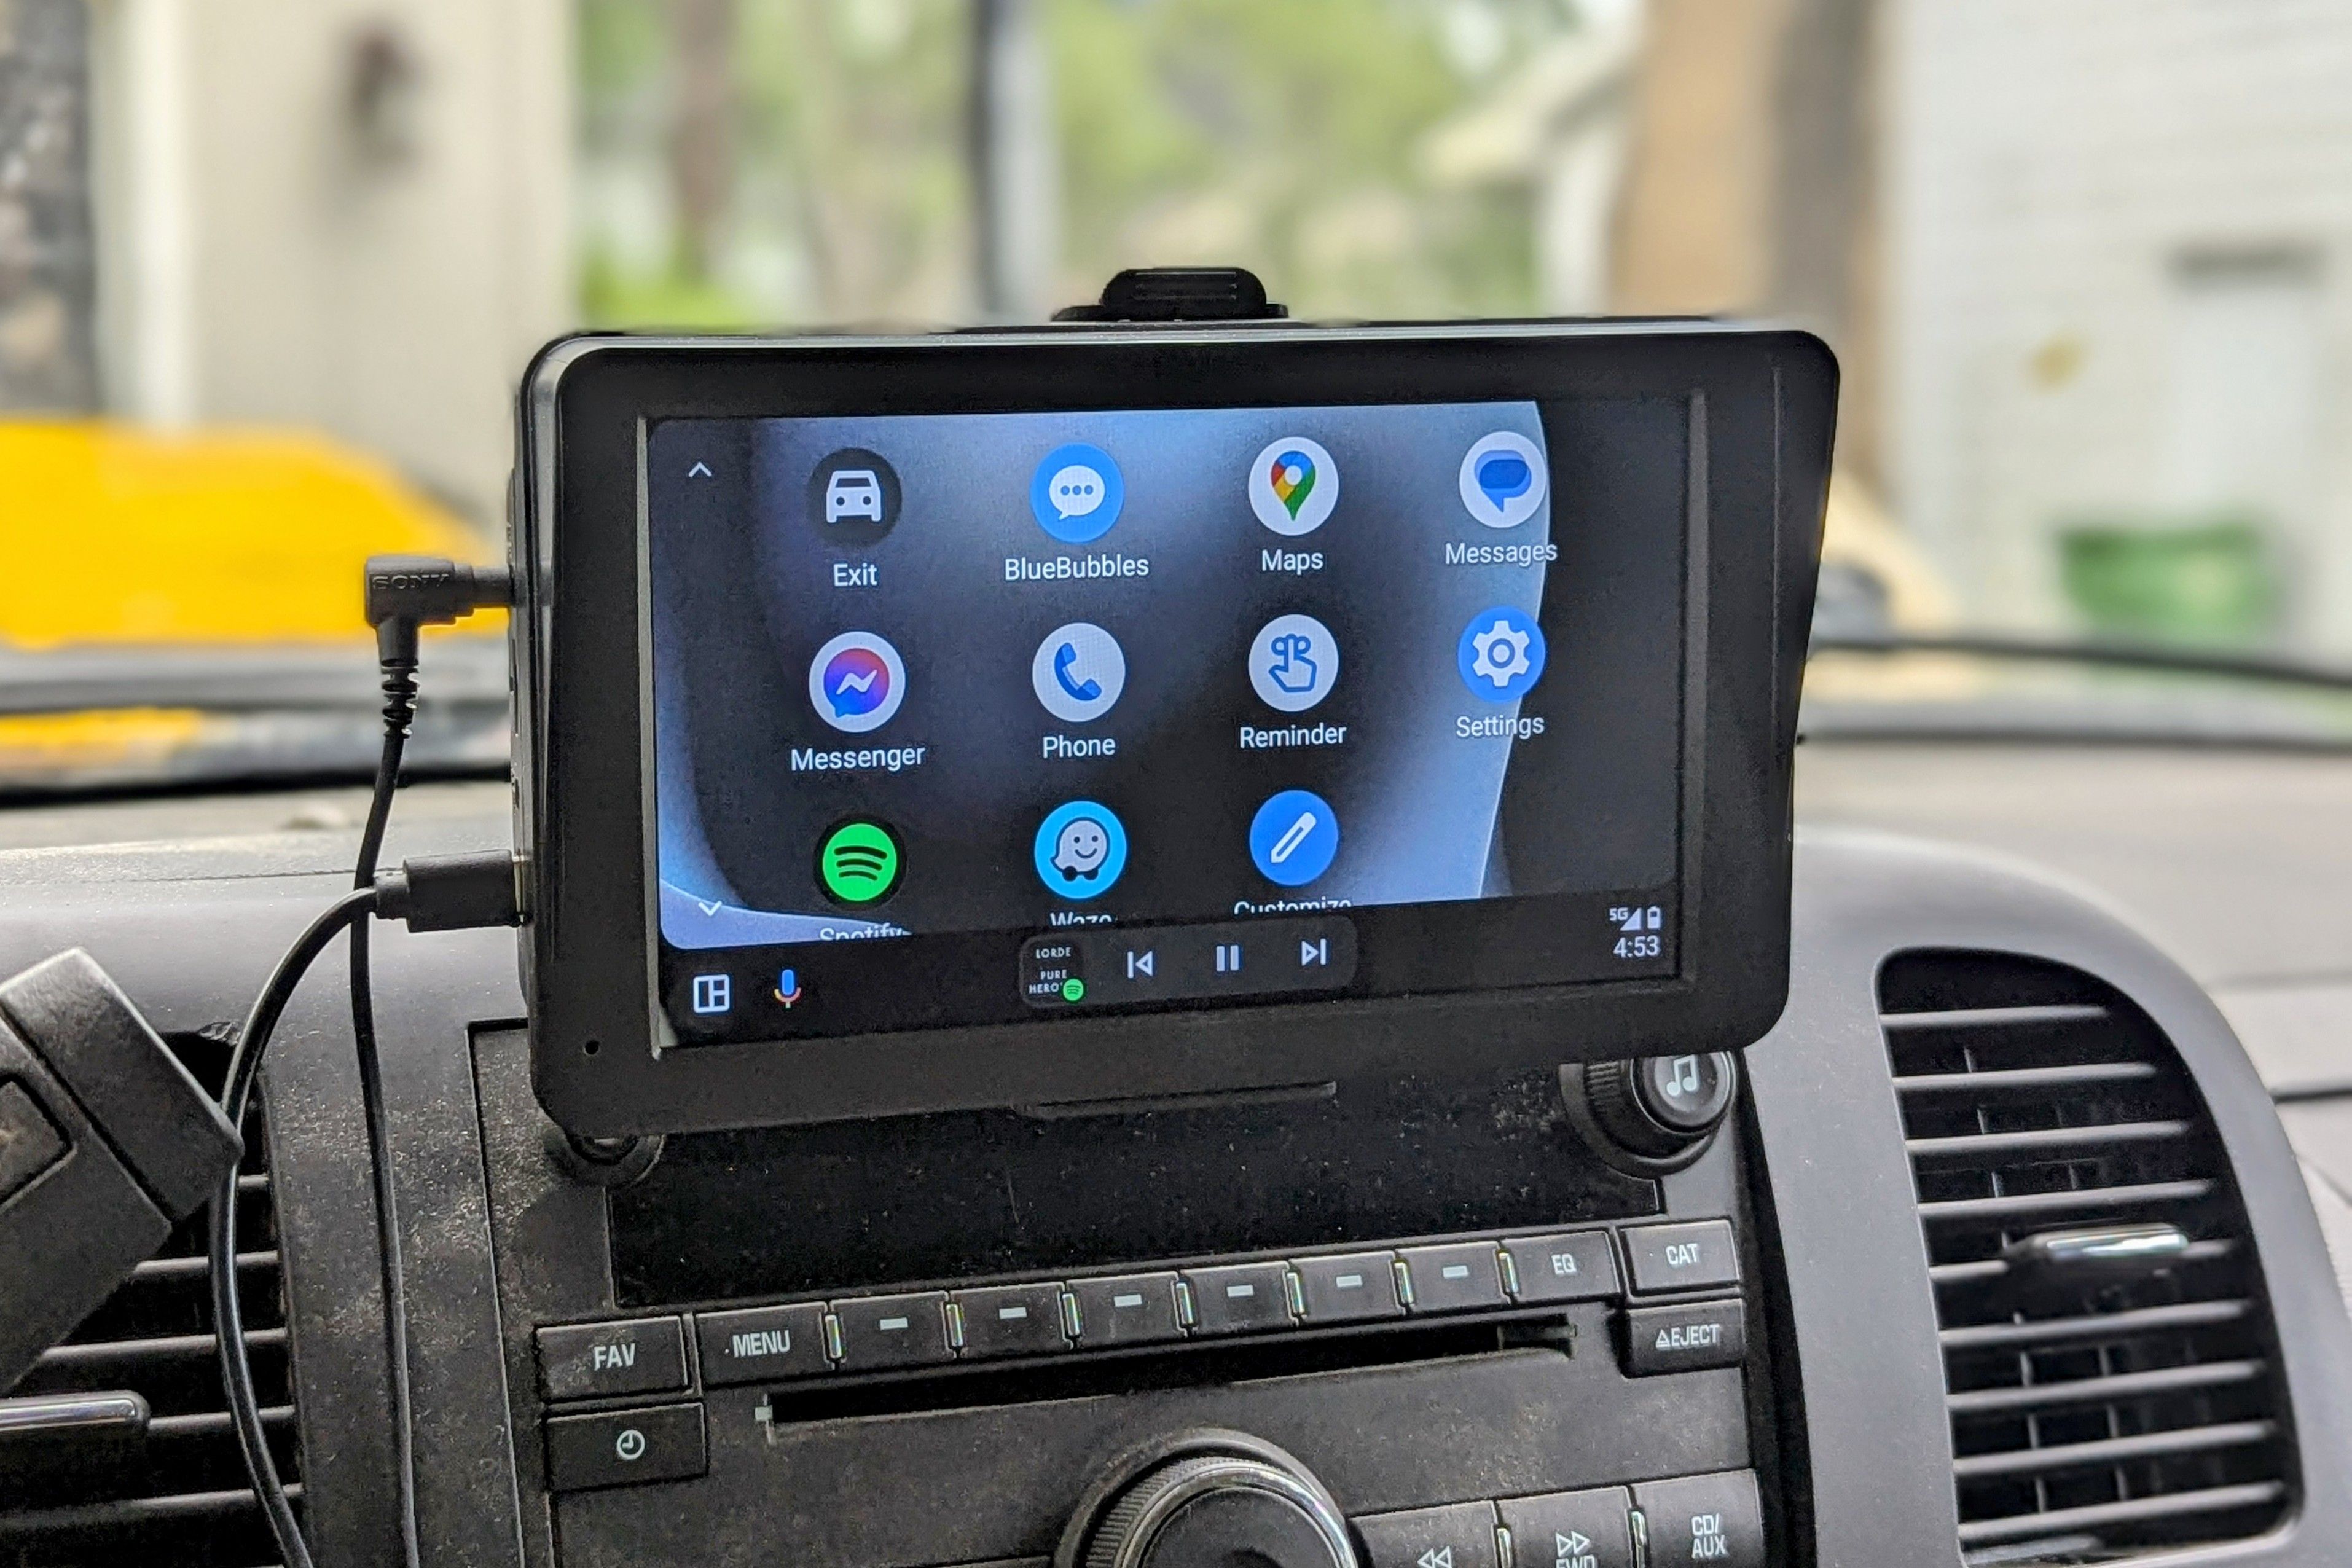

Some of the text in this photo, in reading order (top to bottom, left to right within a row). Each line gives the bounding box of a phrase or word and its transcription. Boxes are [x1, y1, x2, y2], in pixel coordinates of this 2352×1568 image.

[1261, 549, 1323, 576] Maps
[1445, 542, 1558, 565] Messages
[833, 563, 877, 587] Exit
[1004, 555, 1149, 581] BlueBubbles
[1240, 722, 1347, 748] Reminder
[1456, 715, 1545, 738] Settings
[1043, 734, 1116, 758] Phone
[791, 747, 925, 771] Messenger
[1609, 907, 1629, 921] 5G
[1035, 947, 1072, 959] LORDE
[1613, 935, 1660, 958] 4:53
[1040, 970, 1067, 980] PURE
[1029, 982, 1063, 994] HERO
[1551, 1254, 1577, 1274] EQ
[1666, 1244, 1698, 1264] CAT
[732, 1330, 791, 1358] MENU
[1671, 1324, 1720, 1346] EJECT
[594, 1343, 635, 1370] FAV
[1691, 1513, 1720, 1535] CD/
[1691, 1535, 1726, 1559] AUX
